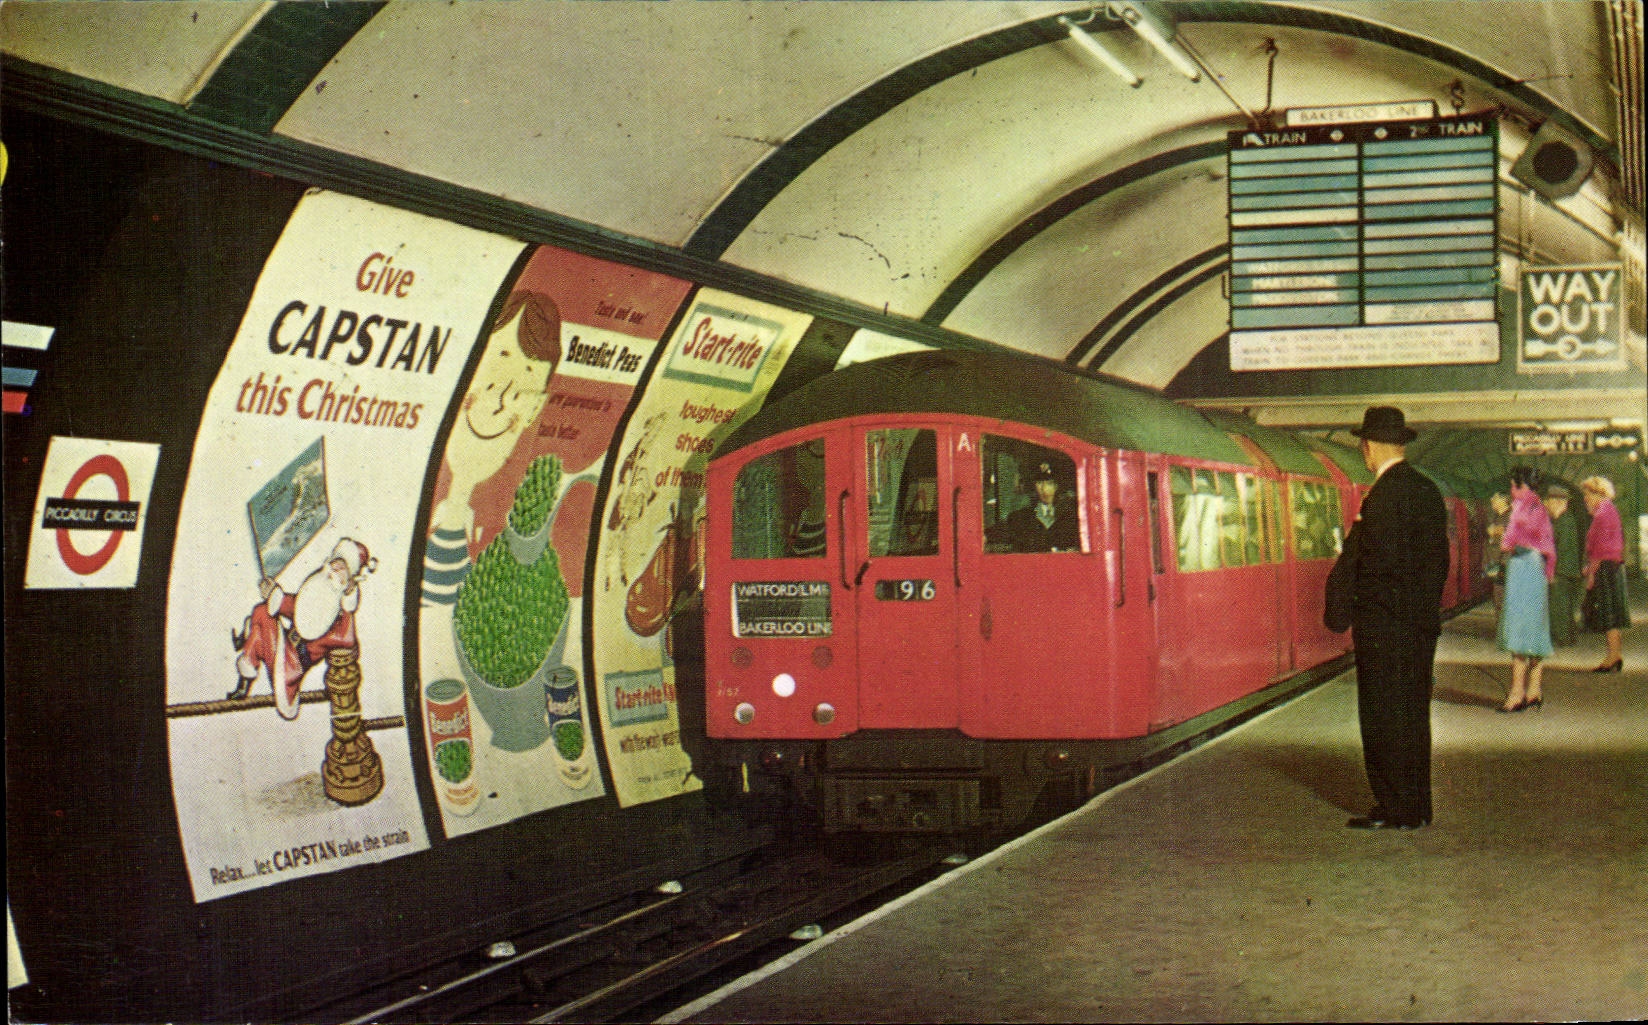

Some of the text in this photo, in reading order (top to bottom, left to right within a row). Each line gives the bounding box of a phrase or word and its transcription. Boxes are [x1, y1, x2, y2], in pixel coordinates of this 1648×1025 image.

[1301, 104, 1418, 122] BAKERLOO LINE
[1263, 131, 1307, 145] TRAIN
[1439, 121, 1483, 137] TRAIN
[356, 252, 415, 298] Give
[1528, 271, 1616, 304] WAY
[1529, 302, 1614, 335] OUT
[268, 300, 452, 375] CAPSTAN
[682, 316, 764, 370] Start-rite
[565, 335, 643, 373] Benedict Peas
[236, 371, 424, 430] this Christmas
[675, 432, 715, 454] shoes
[957, 432, 972, 452] A
[655, 465, 673, 488] of
[45, 506, 138, 523] PICCADILLY CIRCUS
[740, 584, 798, 597] WATFORD
[900, 580, 936, 600] 96
[740, 622, 805, 634] BAKERLOO
[273, 839, 339, 872] CAPSTAN
[338, 838, 362, 857] take
[362, 833, 381, 852] the
[381, 829, 411, 848] strain
